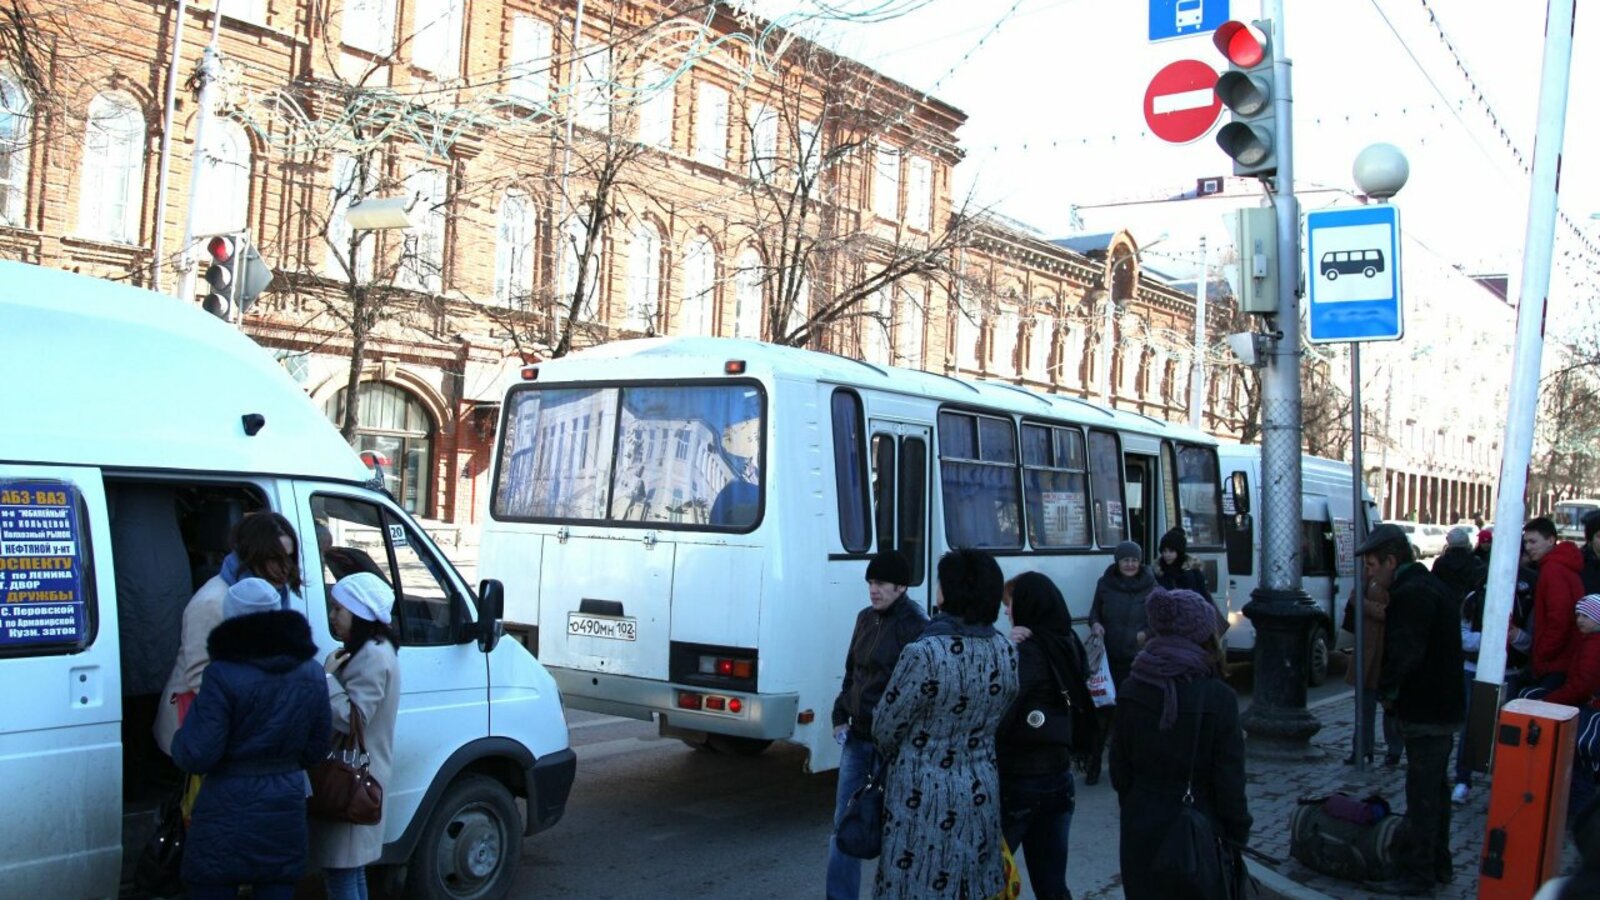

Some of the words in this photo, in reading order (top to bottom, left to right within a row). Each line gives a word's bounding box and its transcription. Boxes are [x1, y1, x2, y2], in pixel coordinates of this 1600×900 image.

[18, 518, 70, 528] КОЛЬЦЕВОЙ
[391, 527, 403, 538] 20
[5, 542, 51, 554] НЕФТЯНОЙ
[12, 572, 27, 580] по
[29, 570, 73, 579] ЛЕНИНА
[10, 580, 40, 591] ДВОР
[6, 590, 74, 603] ДРУЖБЫ
[13, 604, 75, 616] Перовской
[5, 620, 16, 628] по
[18, 616, 75, 628] Армавирской
[42, 627, 76, 636] затон
[616, 622, 633, 635] 102
